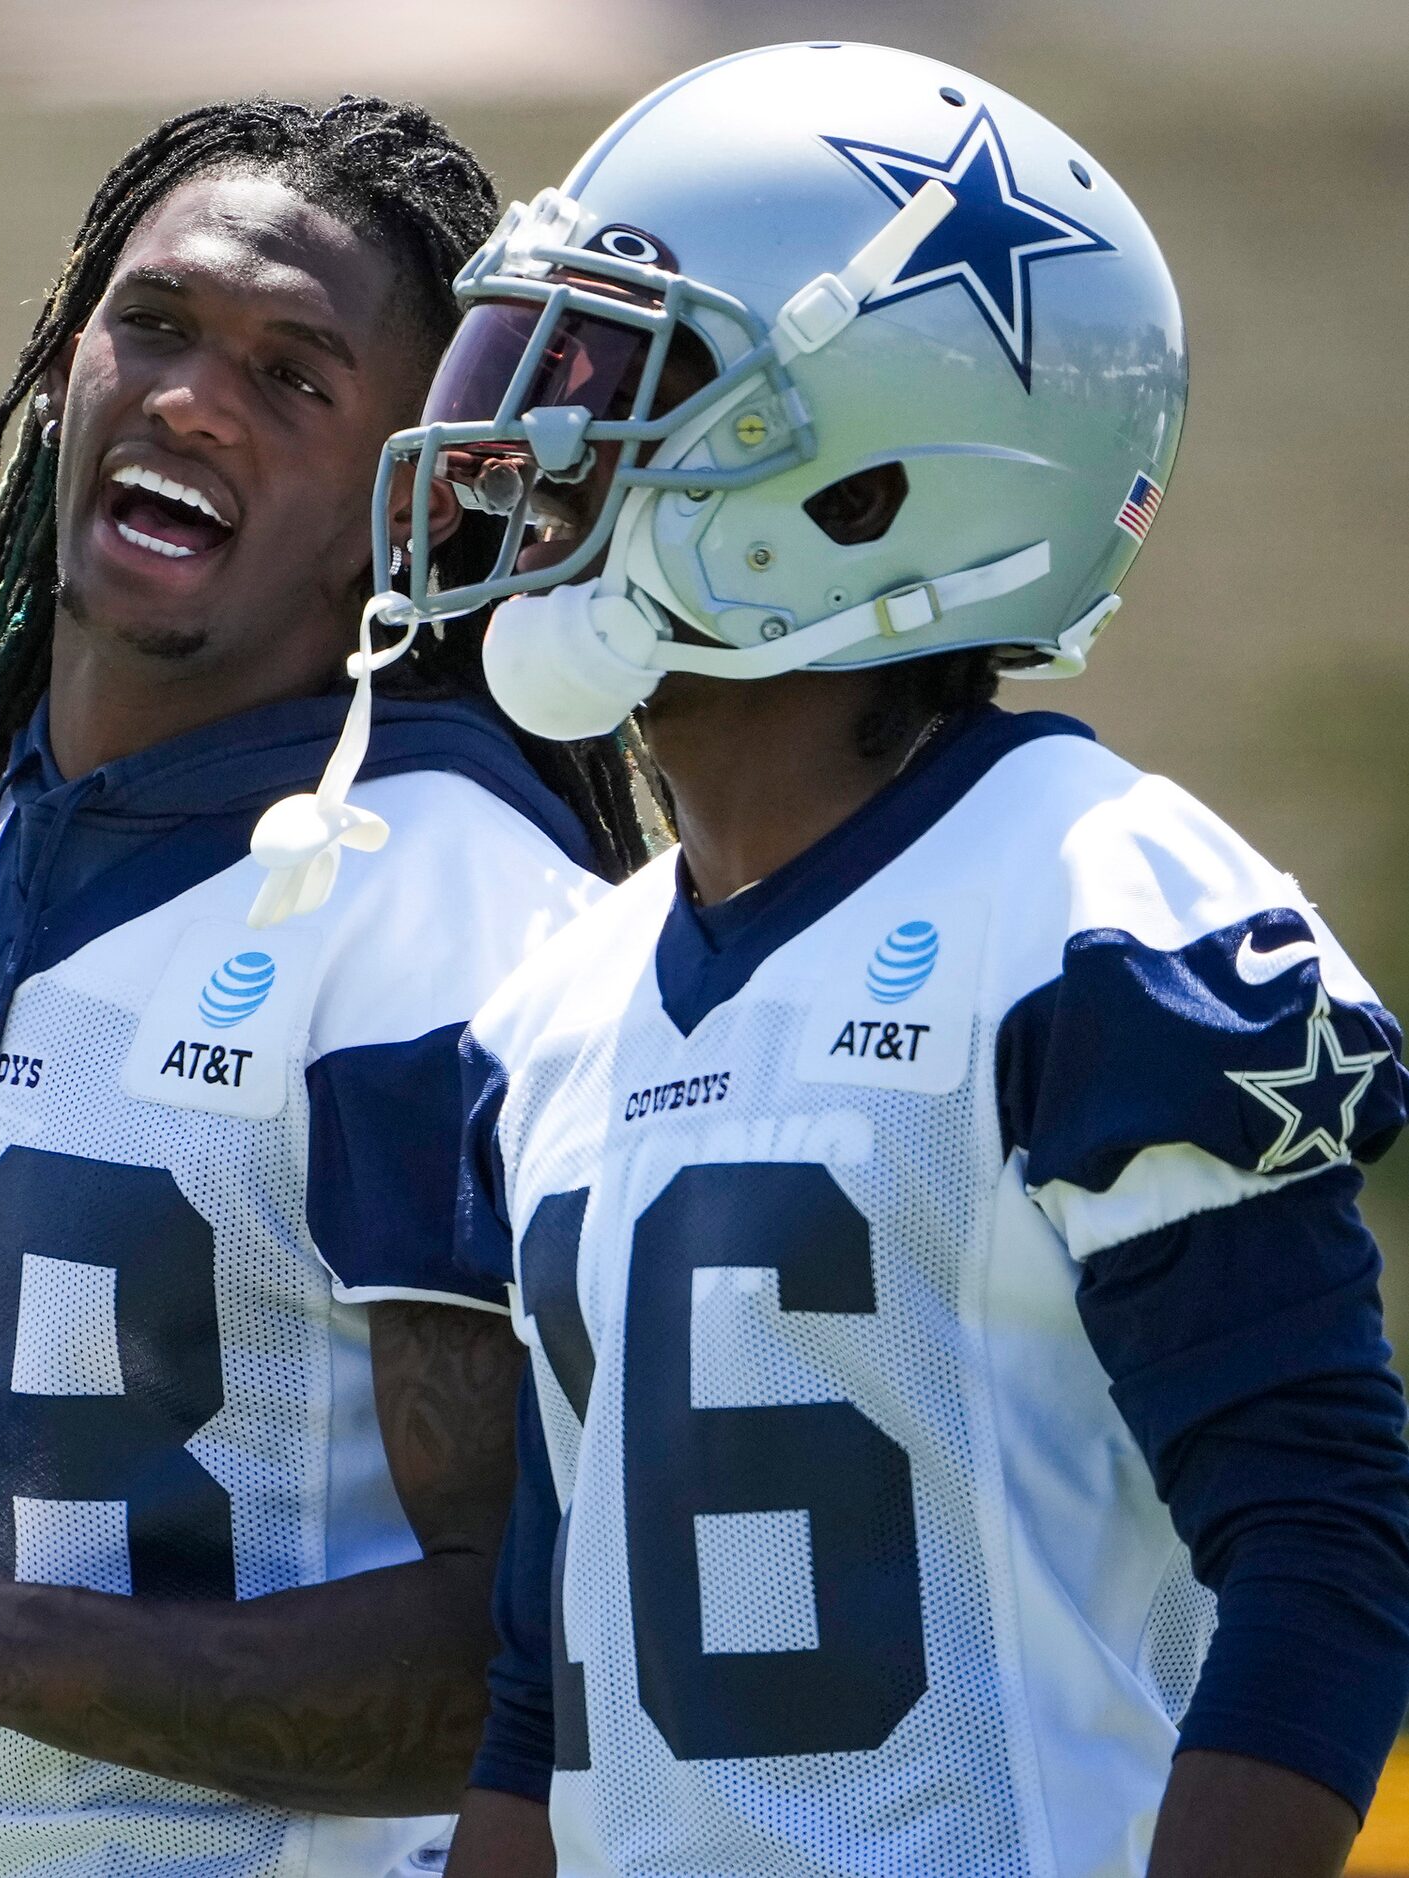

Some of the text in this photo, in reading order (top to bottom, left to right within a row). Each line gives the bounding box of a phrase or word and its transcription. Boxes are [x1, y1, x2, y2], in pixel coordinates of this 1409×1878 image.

[159, 1039, 254, 1088] AT&T
[829, 1019, 931, 1062] AT&T
[624, 1070, 731, 1122] COWBOYS
[519, 1160, 930, 1772] 16
